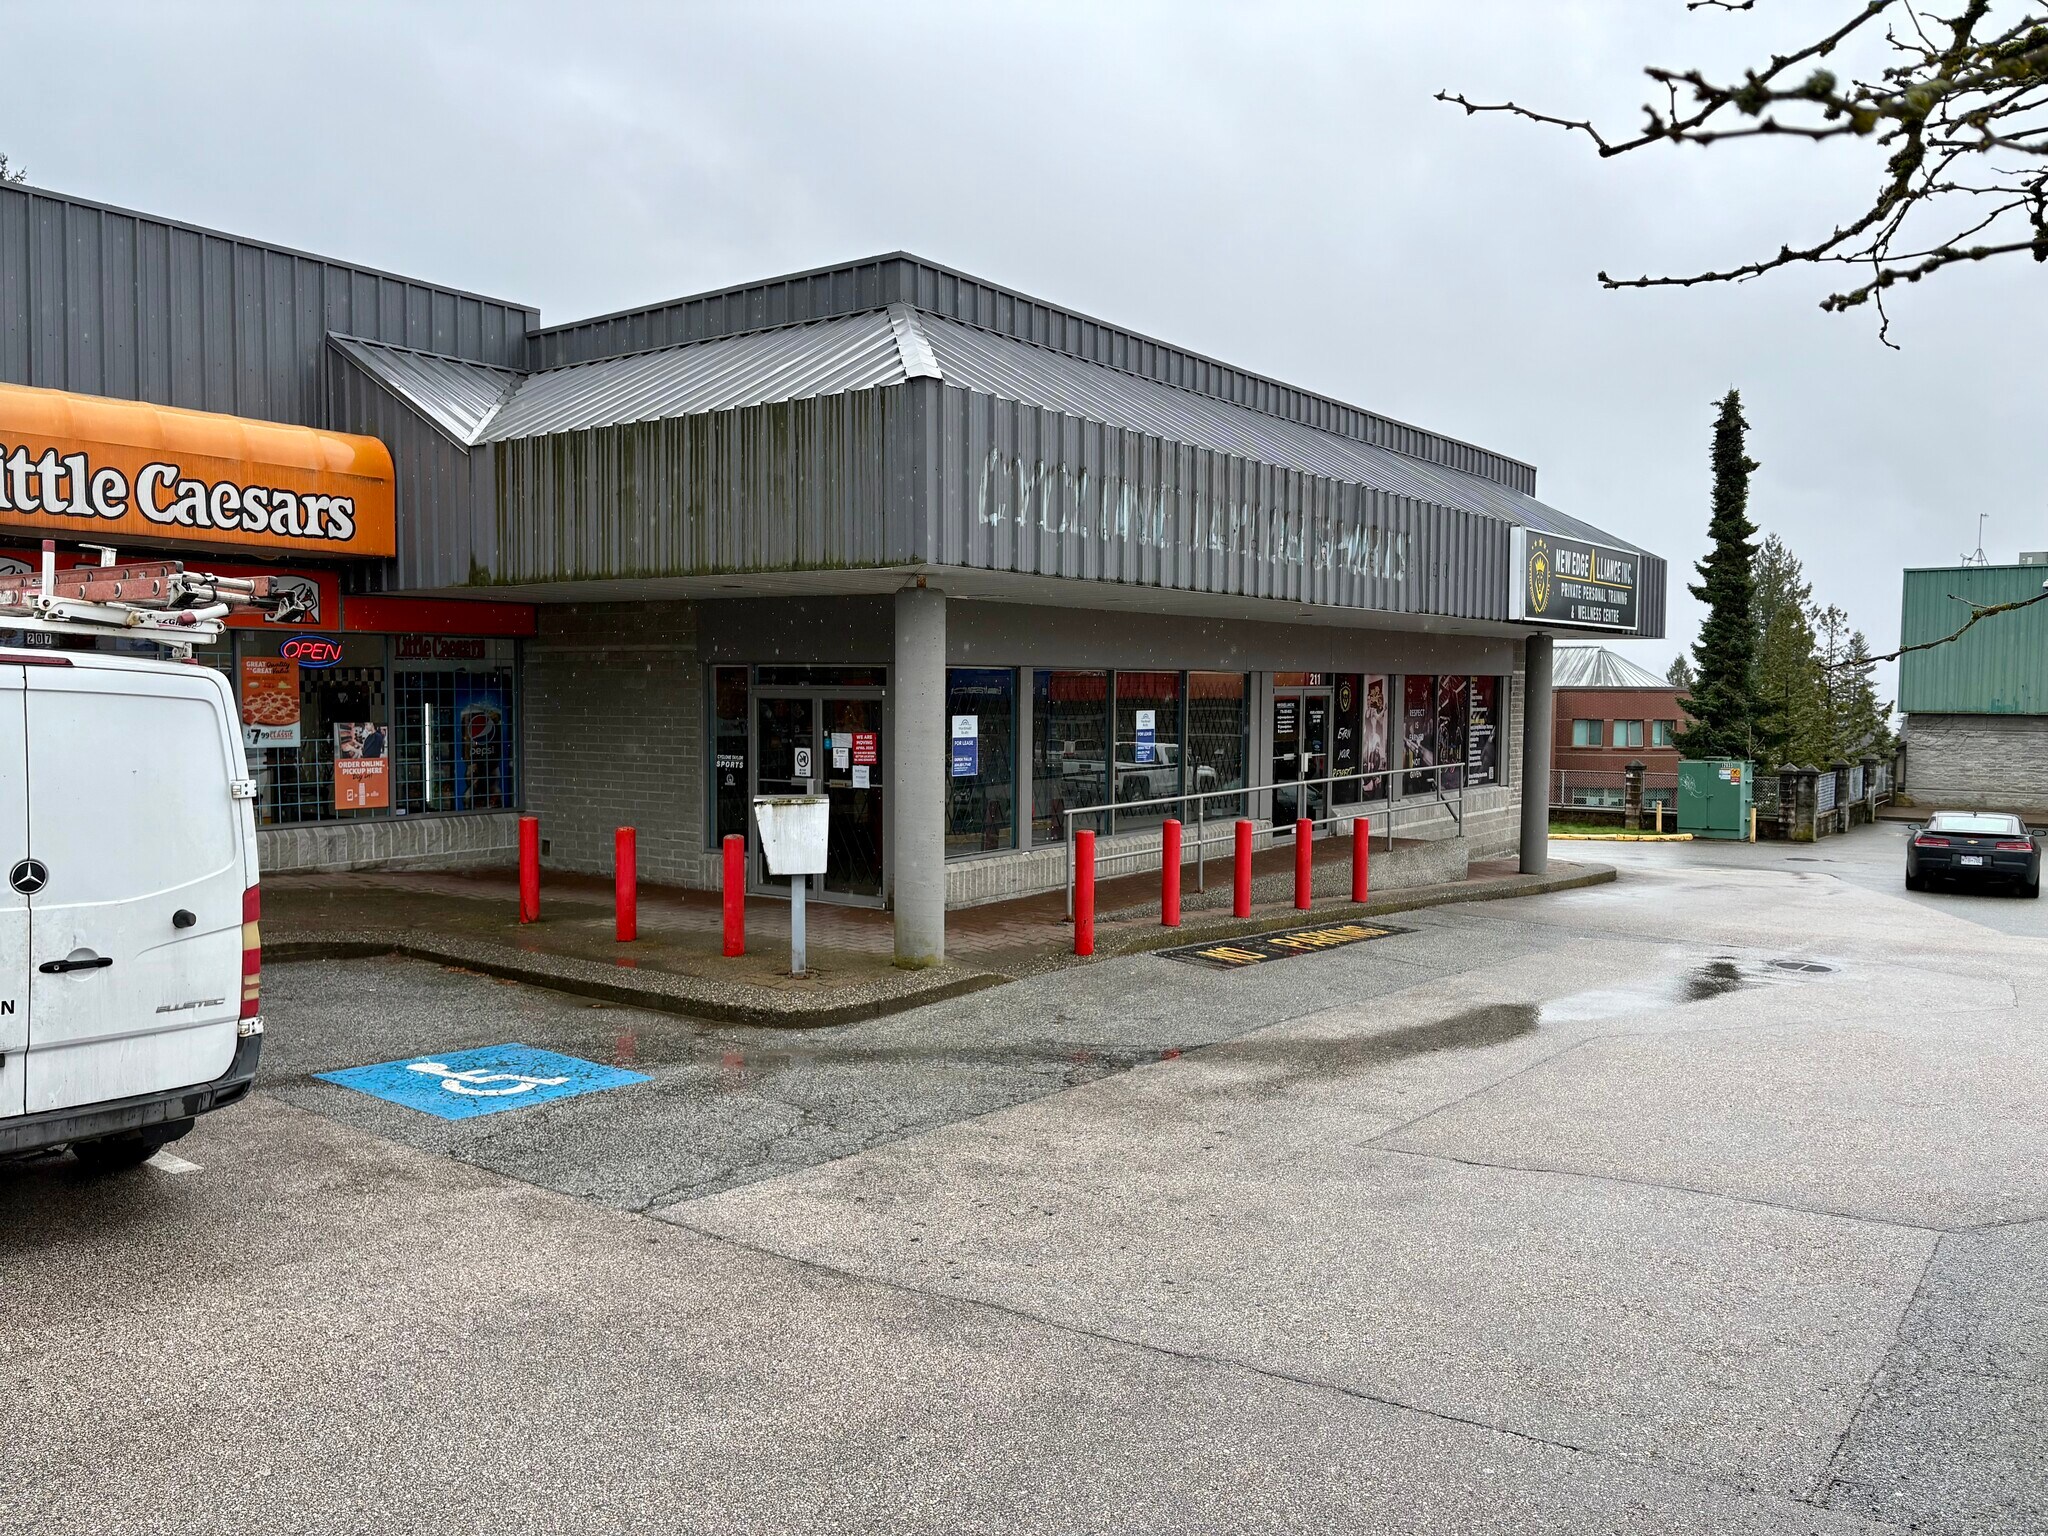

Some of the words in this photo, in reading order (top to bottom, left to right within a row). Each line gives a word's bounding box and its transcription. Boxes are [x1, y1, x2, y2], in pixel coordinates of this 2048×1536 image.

[134, 462, 356, 541] Caesars
[1555, 548, 1571, 574] NEW
[1572, 551, 1589, 577] EDGE
[1561, 582, 1581, 599] PRIVATE
[1583, 586, 1606, 602] PERSONAL
[1608, 589, 1627, 605] TRAINING
[1578, 605, 1601, 621] WELLNESS
[1603, 608, 1619, 623] CENTRE
[27, 633, 51, 644] 207
[283, 641, 342, 660] OPEN
[1310, 674, 1321, 685] 211
[1409, 708, 1425, 717] RESPECT
[470, 746, 494, 756] pepsi
[716, 761, 744, 769] SPORTS
